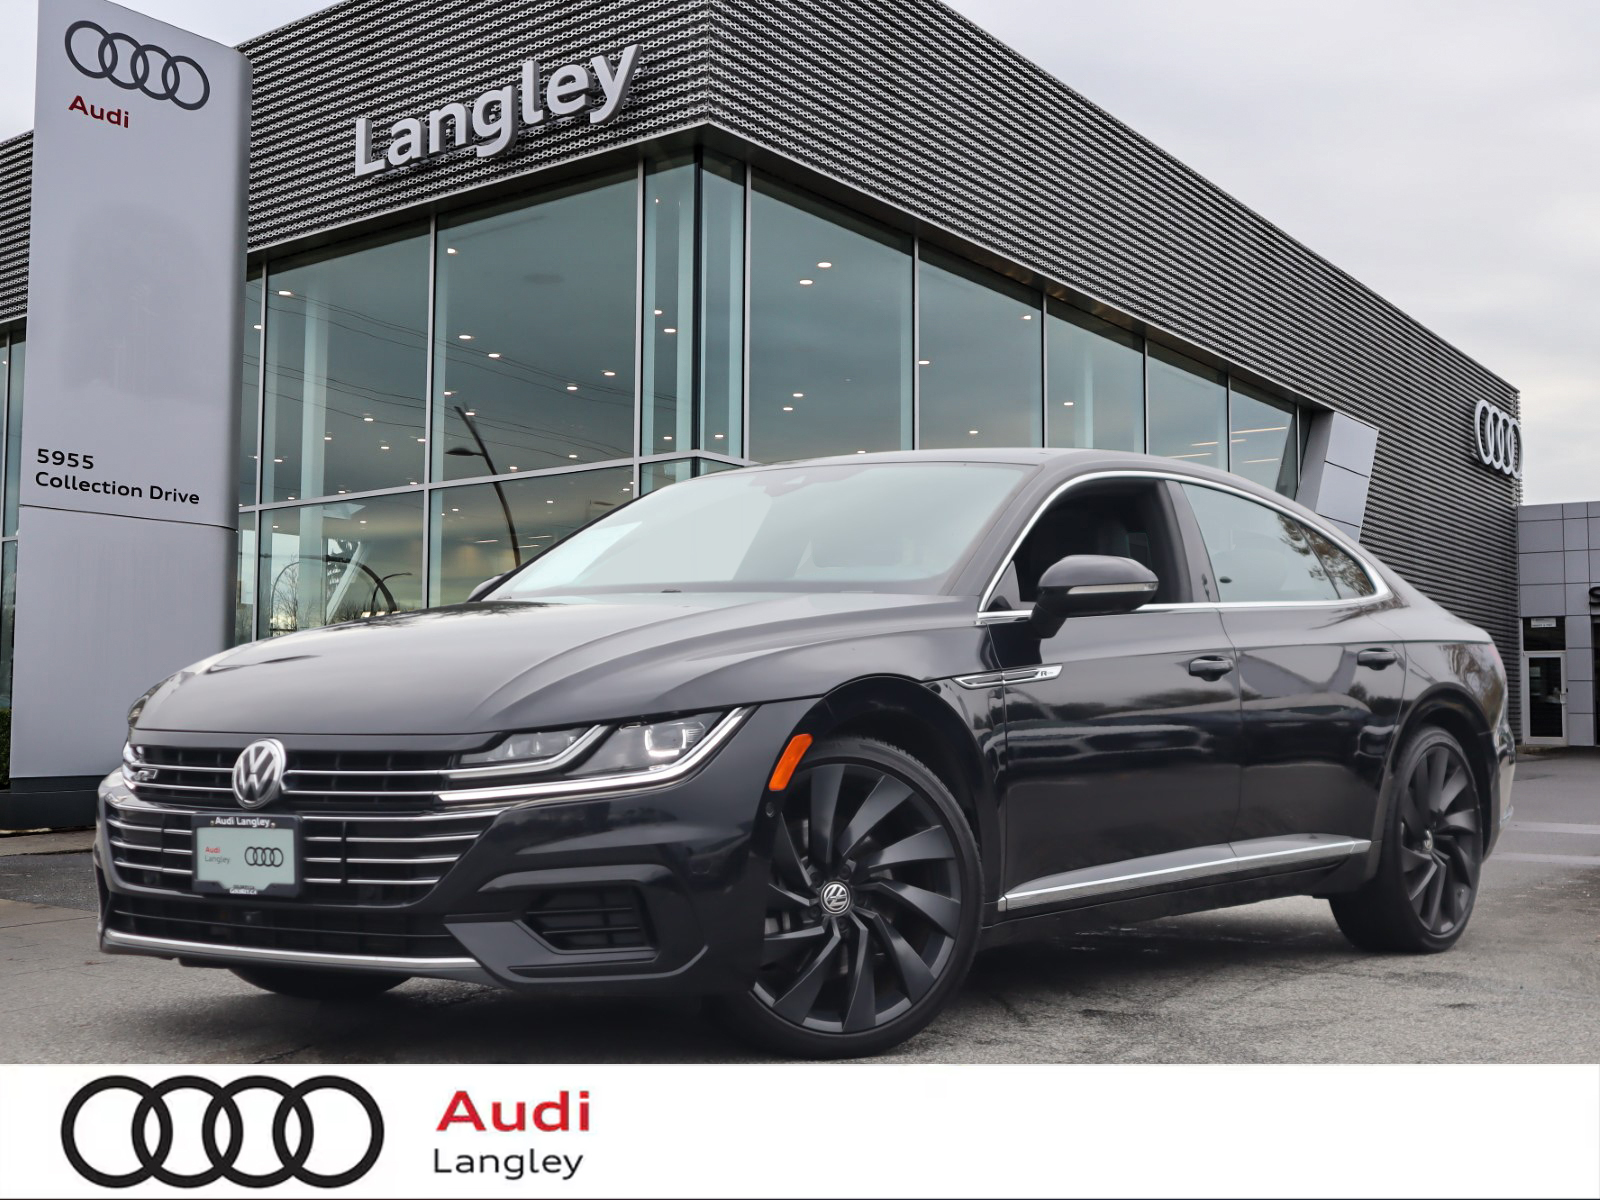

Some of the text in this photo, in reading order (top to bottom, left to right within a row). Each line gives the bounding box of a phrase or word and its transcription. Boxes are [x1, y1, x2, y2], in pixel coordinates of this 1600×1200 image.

[68, 95, 129, 128] Audi
[355, 44, 643, 177] Langley
[37, 448, 94, 470] 5955
[35, 471, 200, 505] Collection Drive
[214, 816, 270, 828] Audi Langley
[204, 855, 230, 864] Langley
[205, 846, 221, 854] Audi
